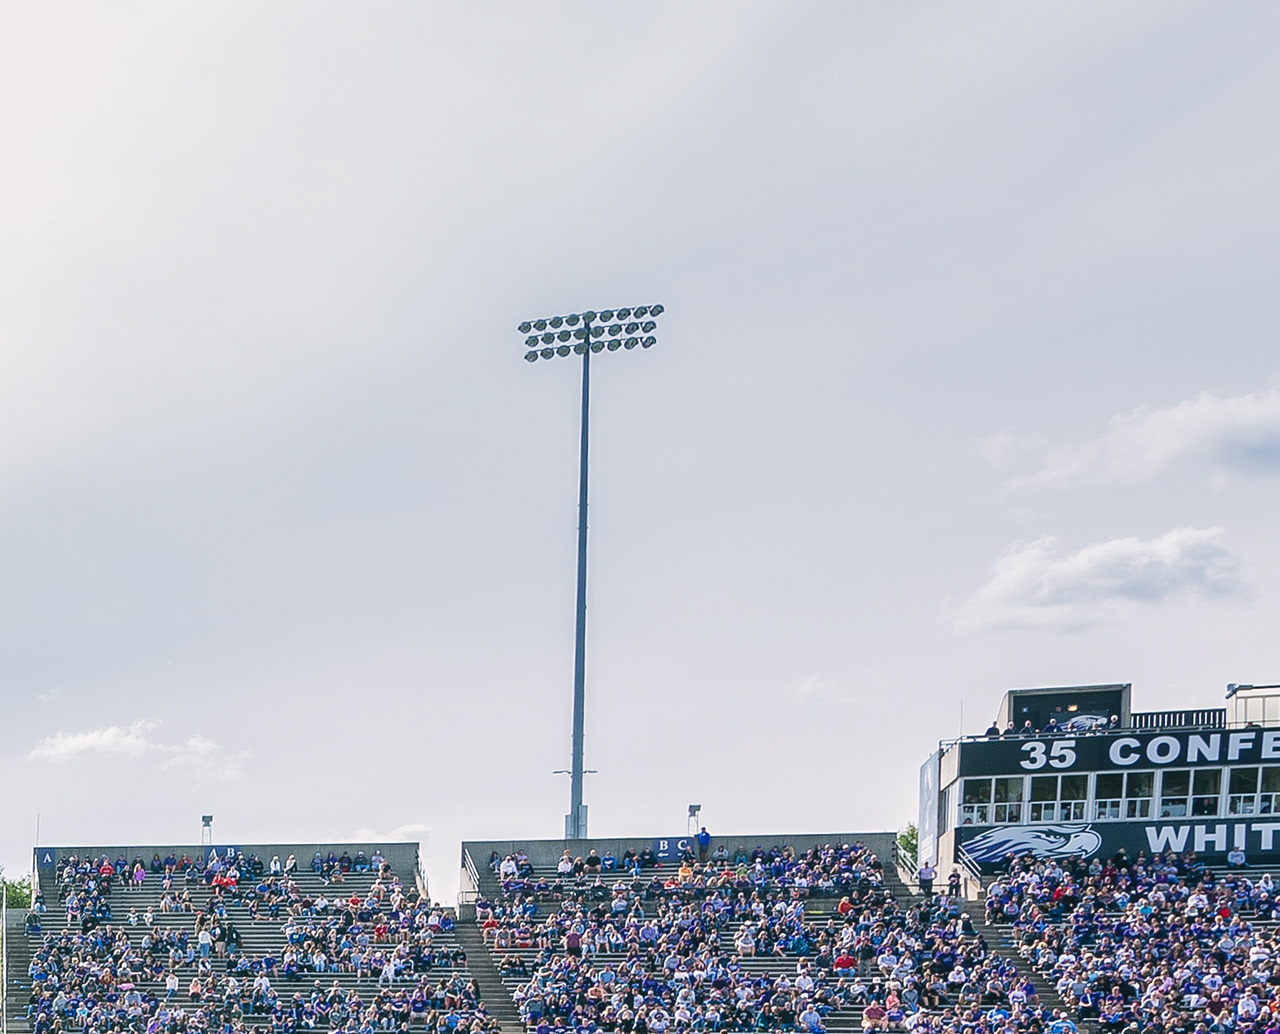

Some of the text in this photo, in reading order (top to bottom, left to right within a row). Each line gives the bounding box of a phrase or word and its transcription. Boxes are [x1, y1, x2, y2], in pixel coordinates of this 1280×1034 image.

[1019, 740, 1077, 770] 35
[659, 840, 688, 851] B C
[227, 847, 235, 857] B
[43, 853, 53, 863] A
